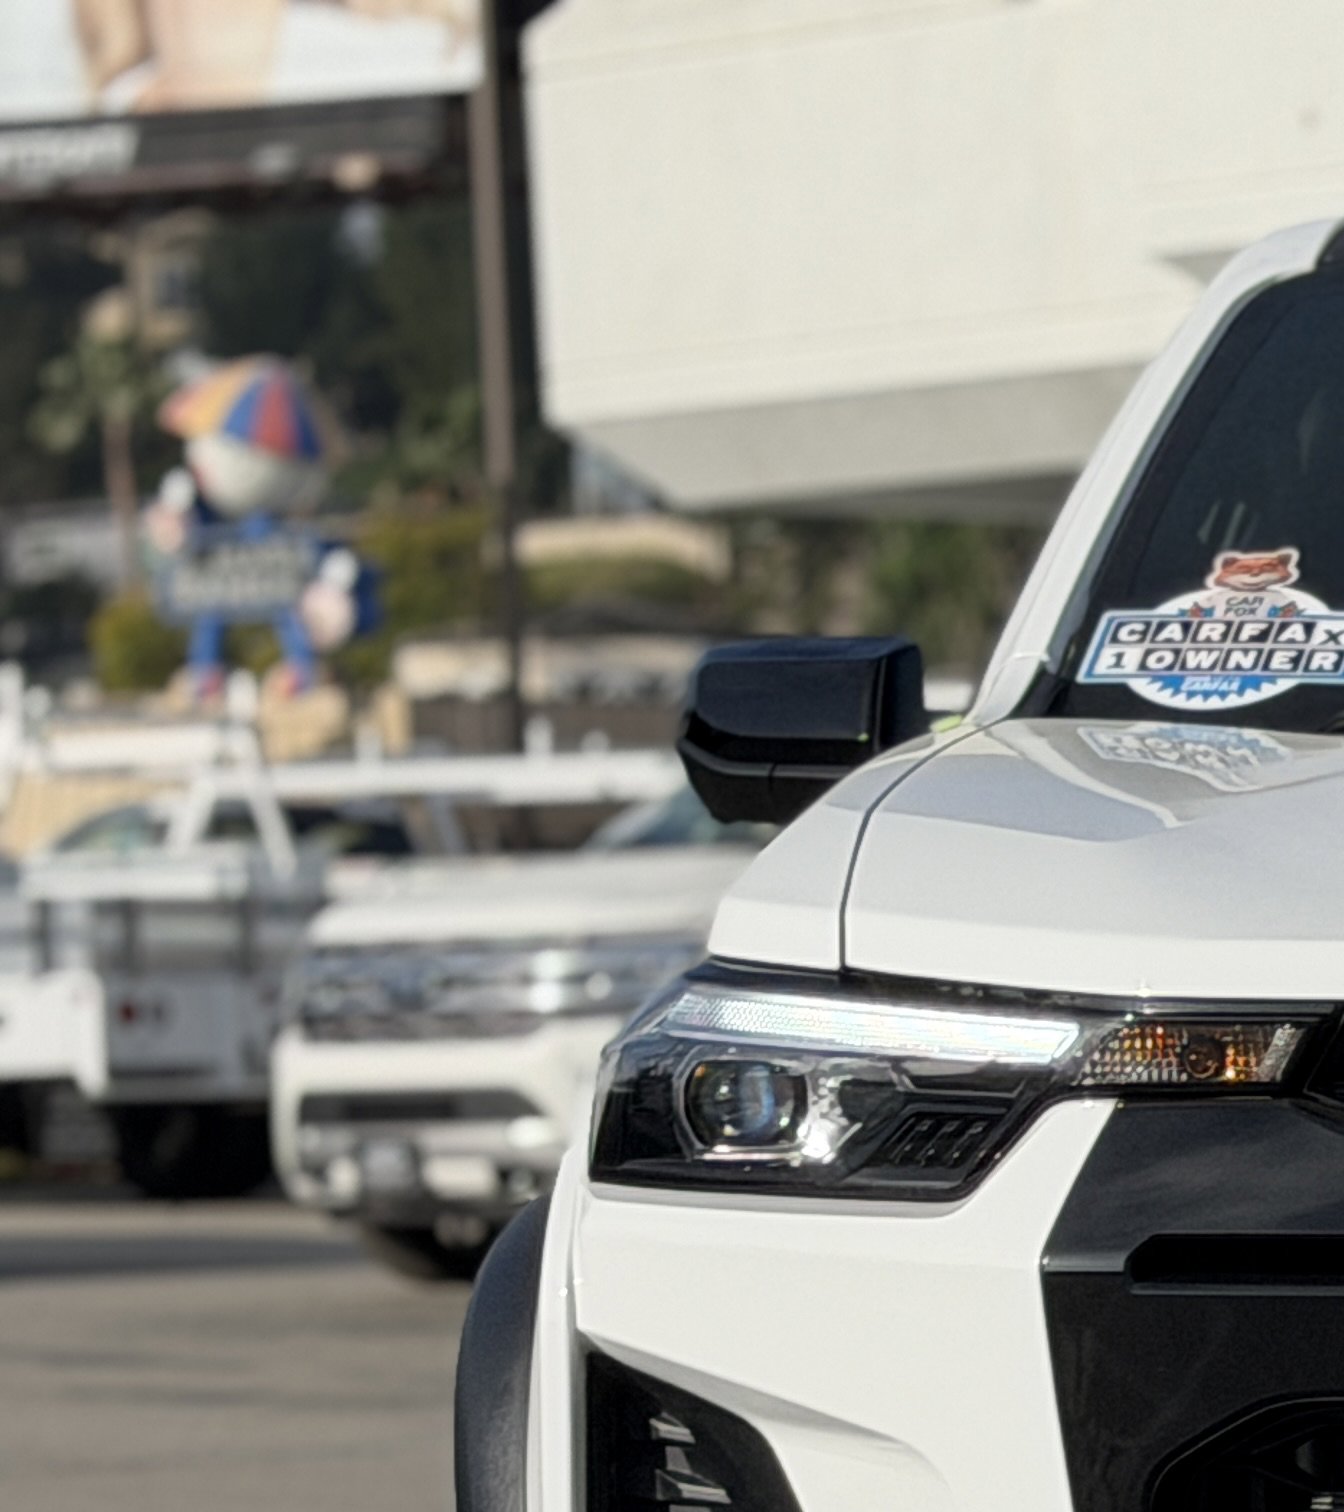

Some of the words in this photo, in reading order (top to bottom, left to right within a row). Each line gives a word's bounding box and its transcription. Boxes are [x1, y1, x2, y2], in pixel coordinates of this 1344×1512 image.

[1225, 595, 1265, 607] CAR
[1223, 607, 1258, 618] FOX
[1105, 651, 1126, 670] 1
[1145, 650, 1343, 671] OWNER
